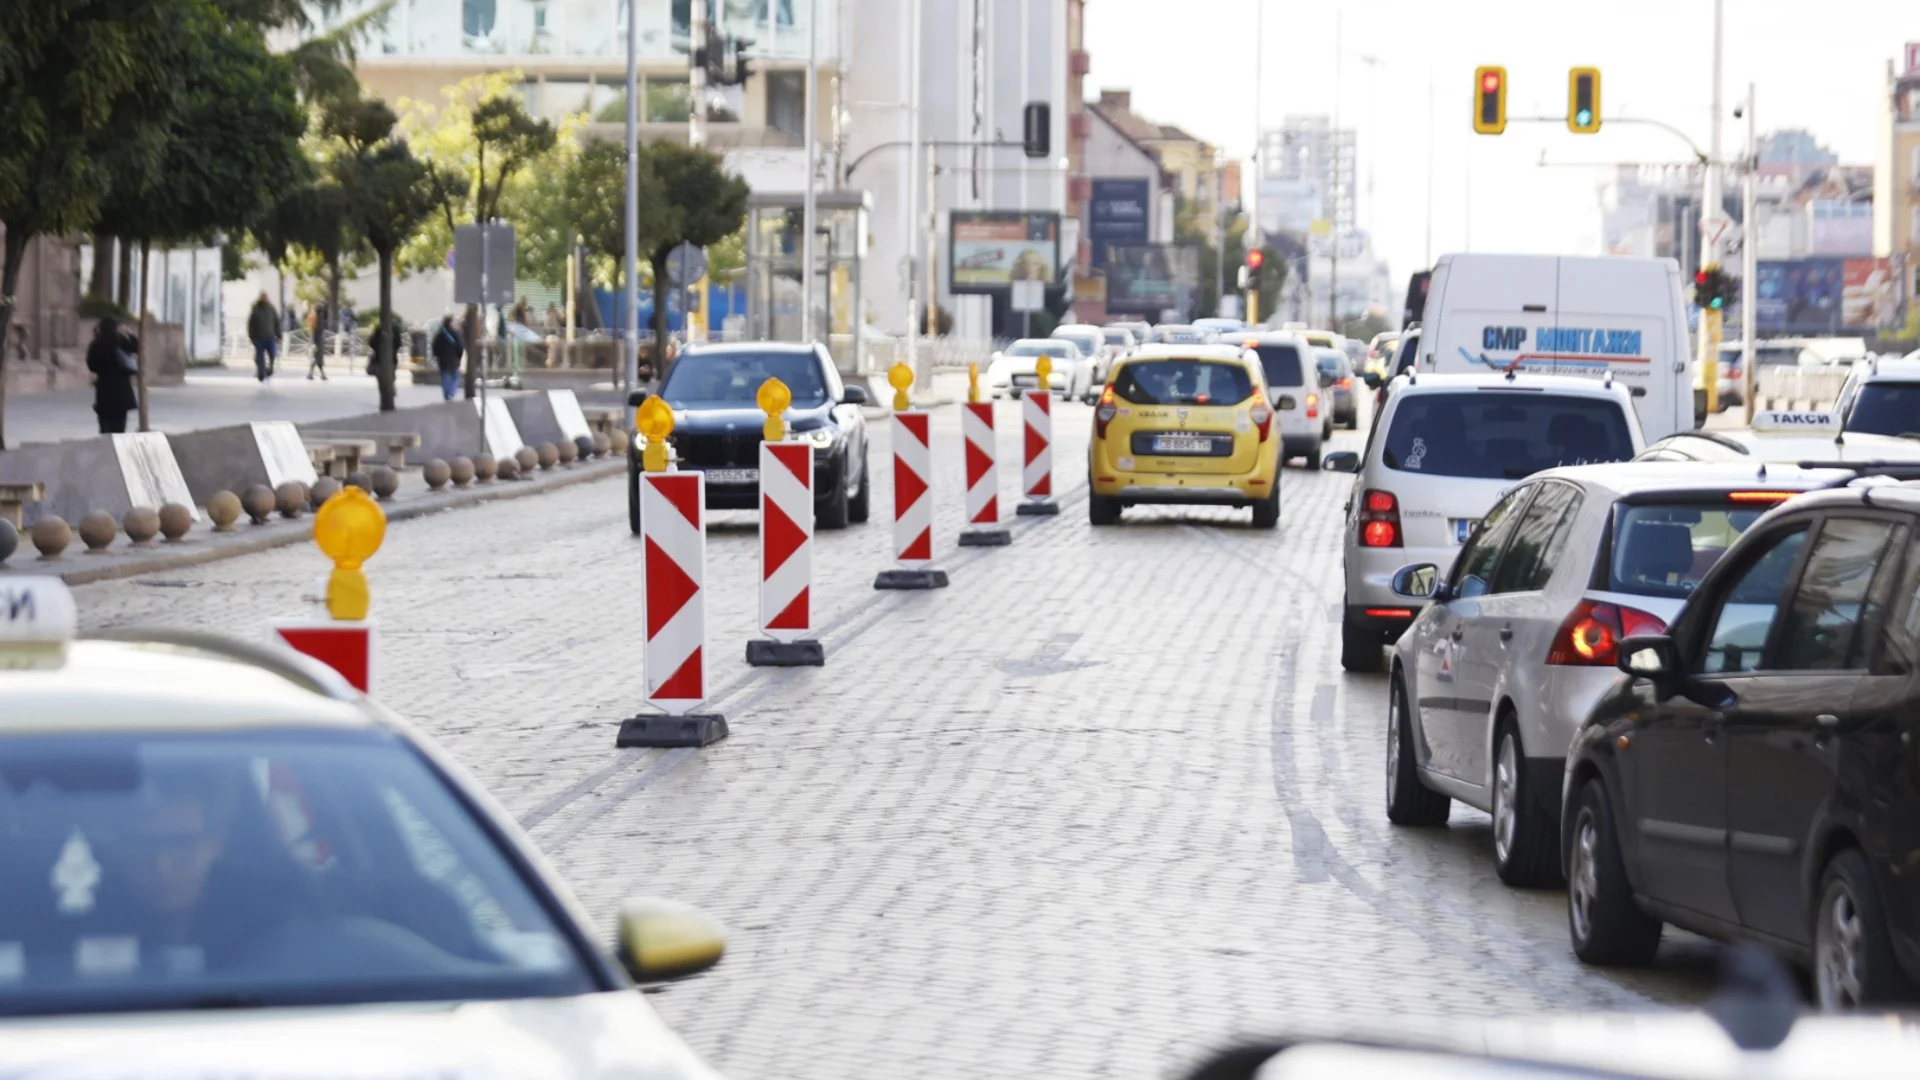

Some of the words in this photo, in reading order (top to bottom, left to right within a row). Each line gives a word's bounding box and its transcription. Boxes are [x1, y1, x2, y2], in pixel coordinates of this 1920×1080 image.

[1483, 325, 1527, 351] СМР
[1536, 327, 1642, 355] МОНТАЖИ
[1771, 413, 1830, 424] ТАКСИ
